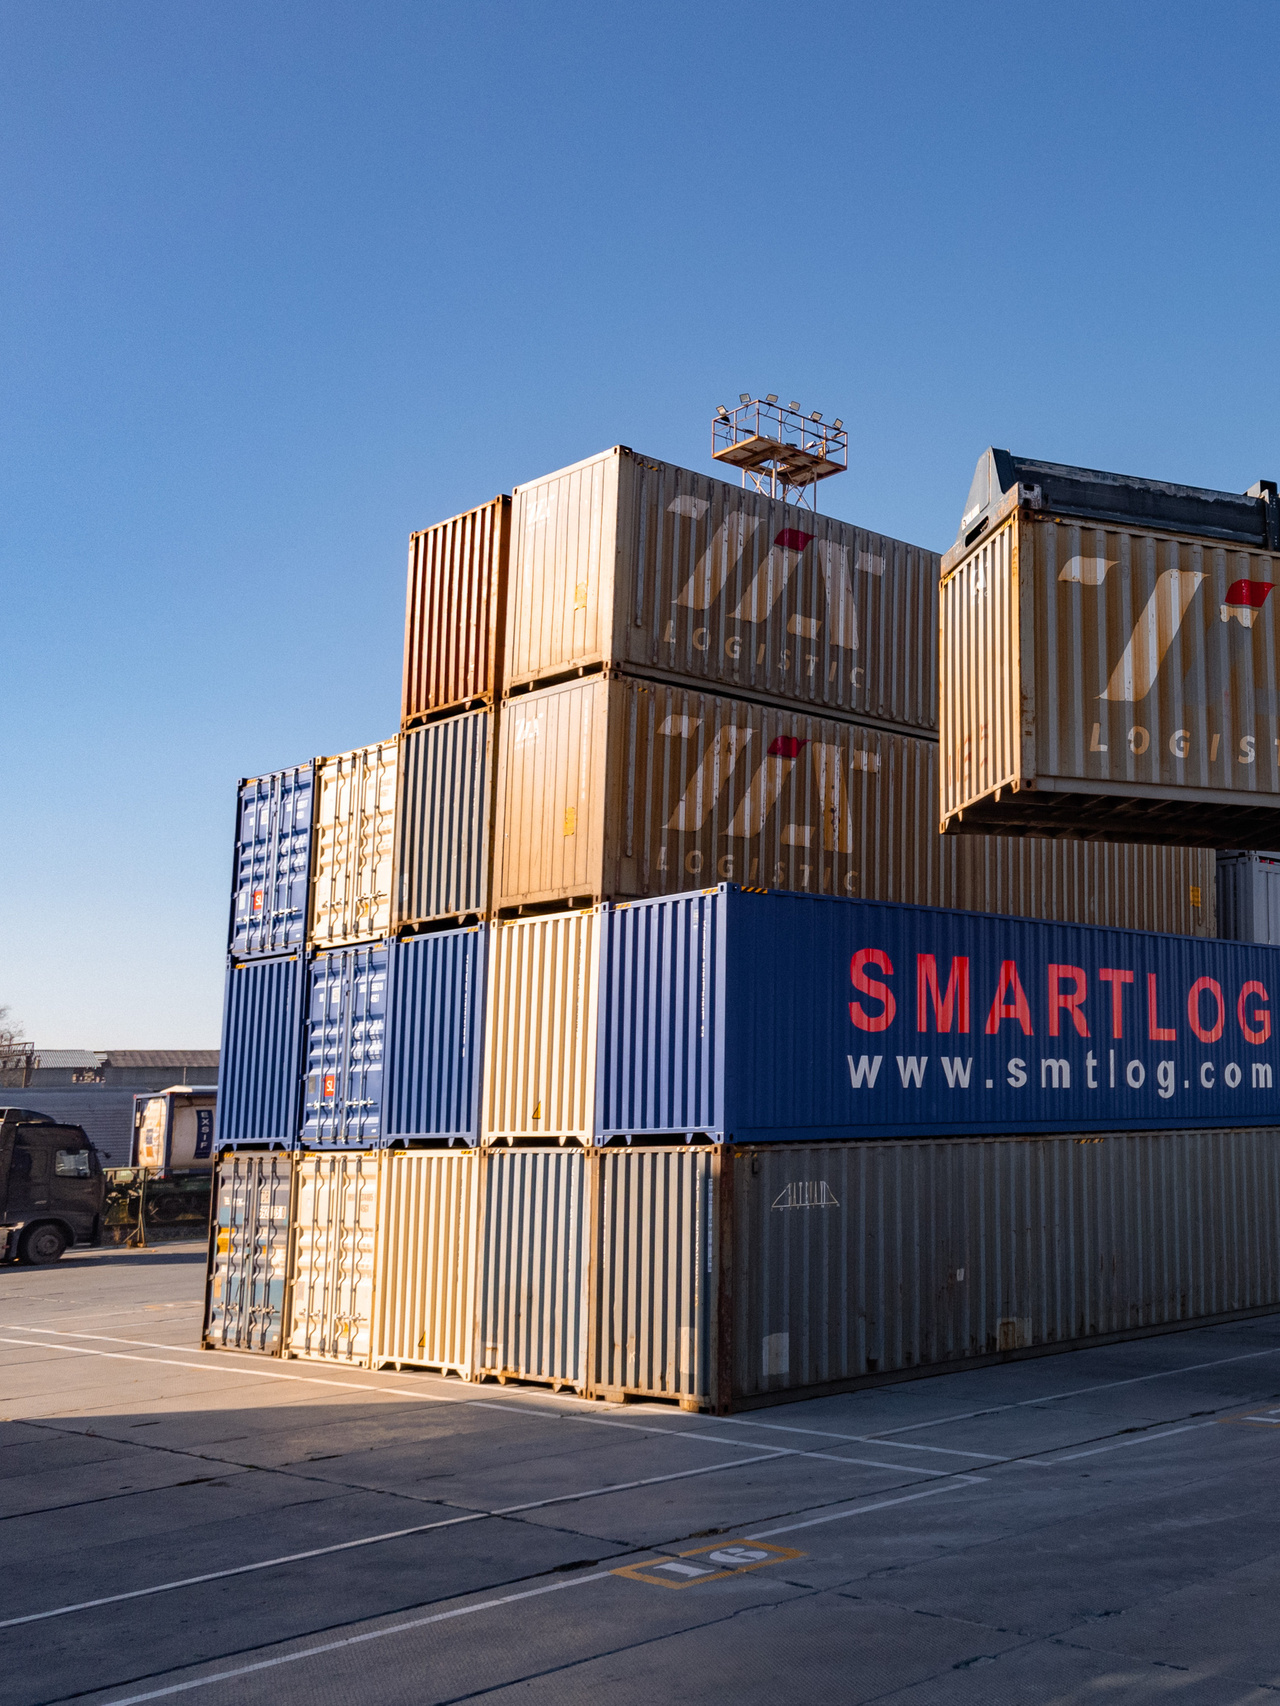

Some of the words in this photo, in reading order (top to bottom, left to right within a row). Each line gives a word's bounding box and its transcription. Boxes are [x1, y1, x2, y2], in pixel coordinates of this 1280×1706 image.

[664, 619, 865, 689] LOGISTIC
[655, 846, 859, 893] LOGISTIC
[848, 948, 1272, 1045] SMARTLOG
[847, 1049, 1273, 1098] www.smtlog.com
[200, 1111, 210, 1149] EXSIF
[653, 1547, 768, 1577] 16
